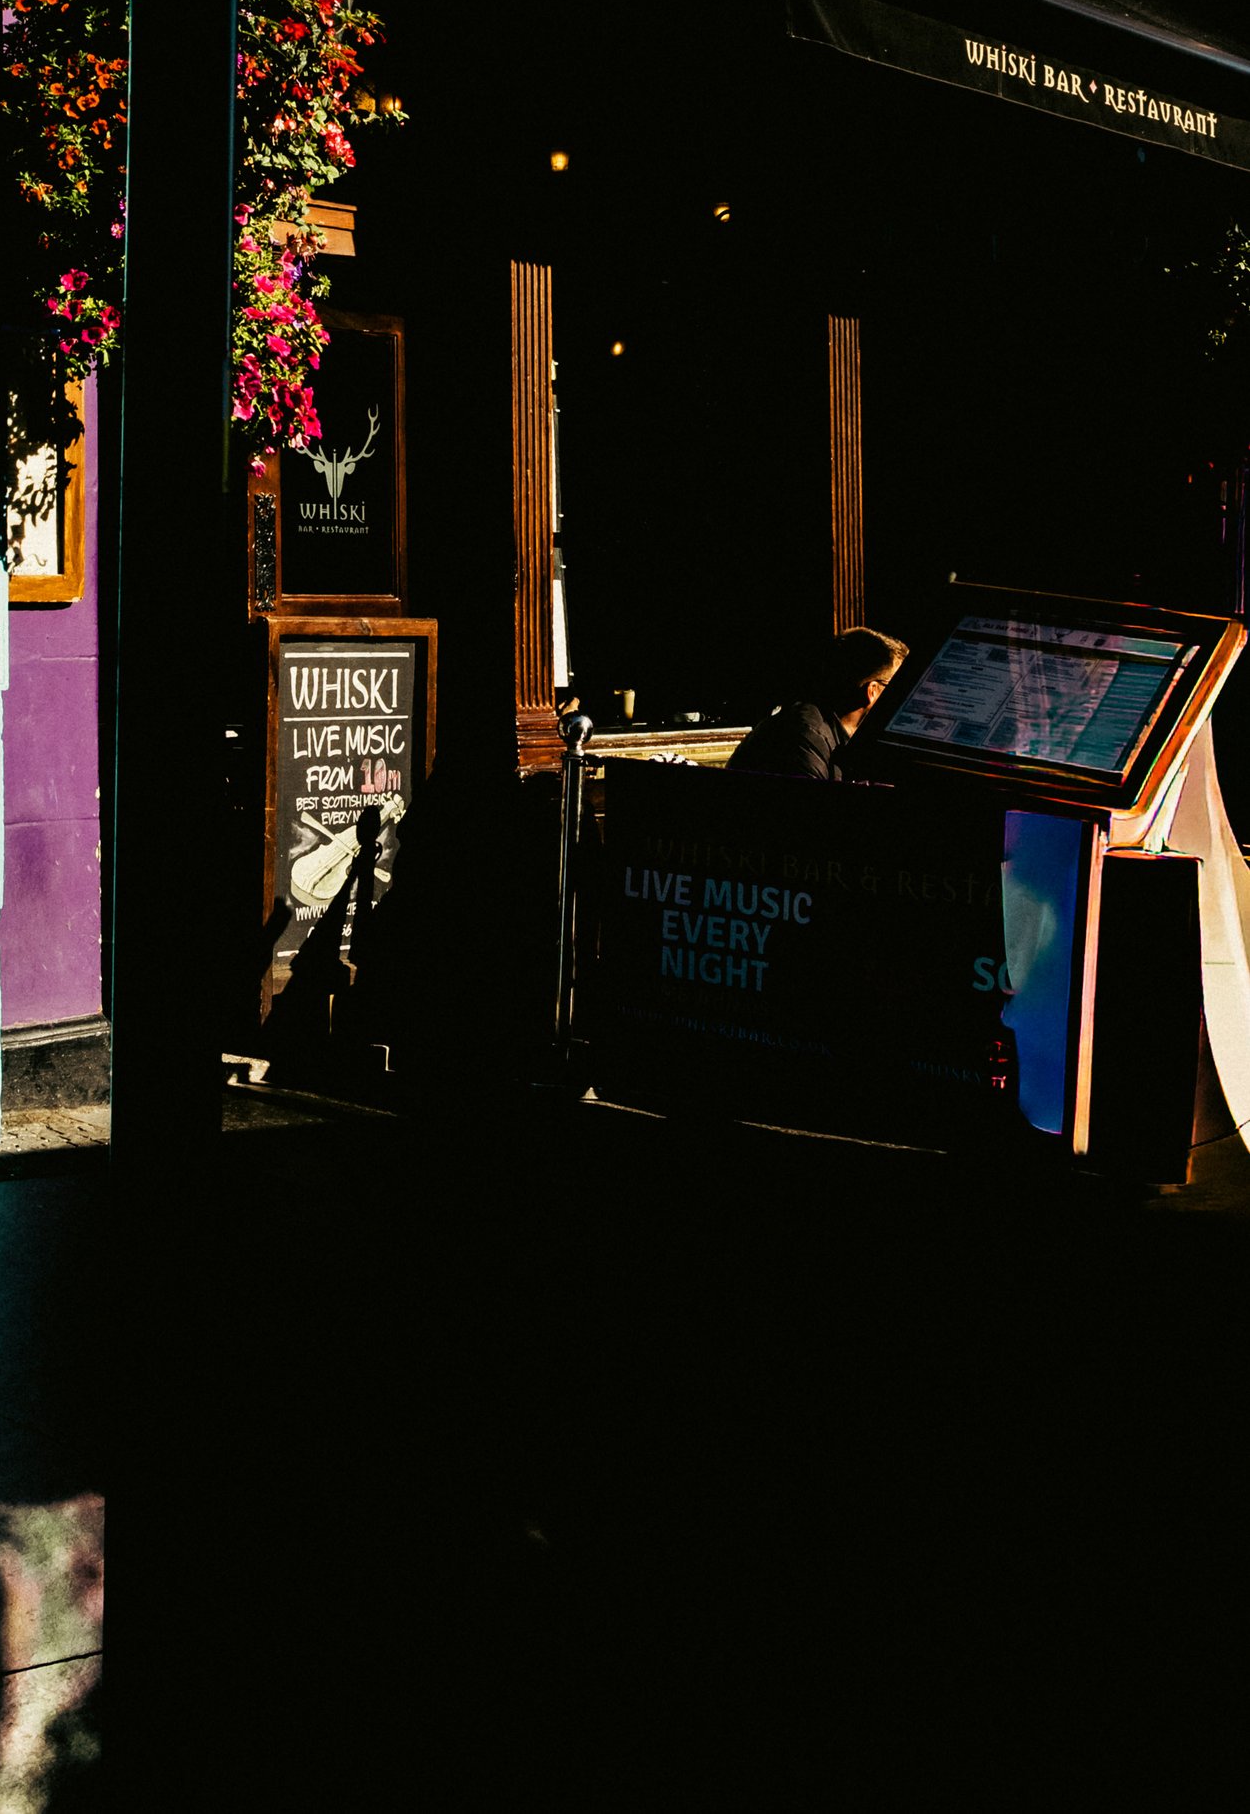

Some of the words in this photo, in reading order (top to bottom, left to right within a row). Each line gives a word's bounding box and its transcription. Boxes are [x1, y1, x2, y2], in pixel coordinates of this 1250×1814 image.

[1043, 64, 1090, 103] BAR
[298, 524, 315, 534] BAR
[290, 666, 398, 714] WHISKI
[293, 726, 343, 759] LIVE
[345, 723, 406, 757] MUSIC
[306, 764, 354, 793] FROM
[296, 796, 319, 812] BEST
[321, 794, 362, 810] SCOTTISH
[321, 810, 352, 826] EVERY
[623, 865, 694, 907] LIVE
[702, 876, 813, 925] MUSIC
[661, 908, 772, 956] EVERY
[659, 944, 770, 993] NIGHT
